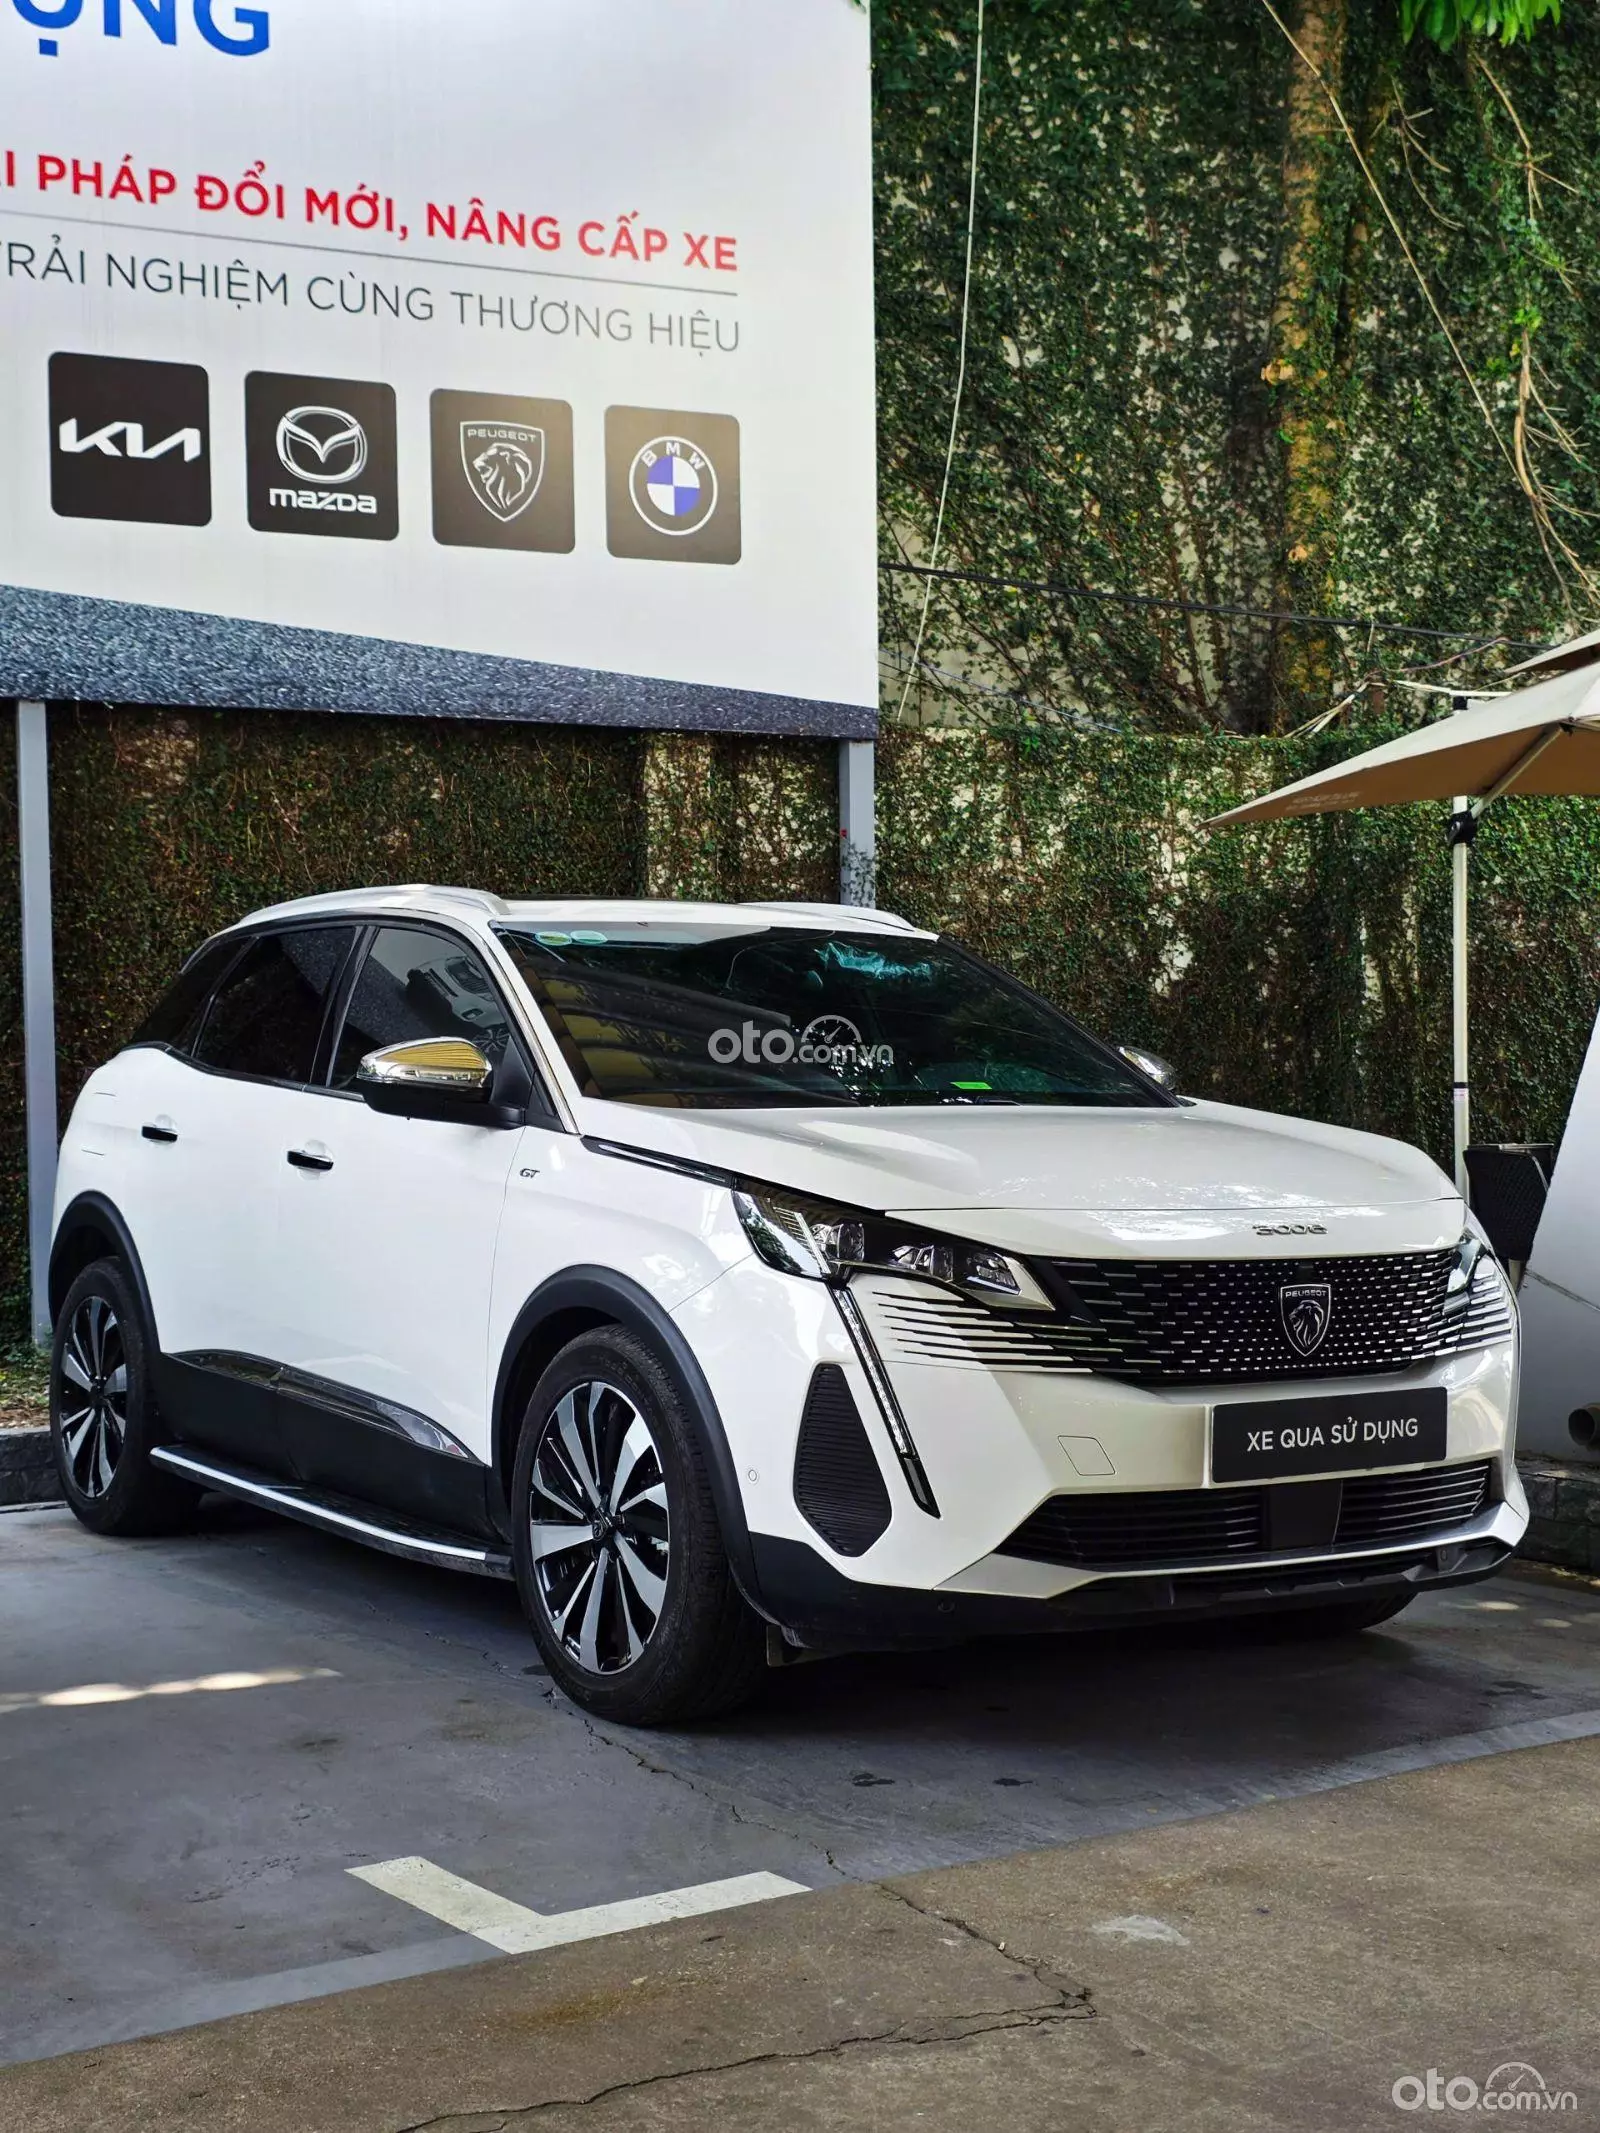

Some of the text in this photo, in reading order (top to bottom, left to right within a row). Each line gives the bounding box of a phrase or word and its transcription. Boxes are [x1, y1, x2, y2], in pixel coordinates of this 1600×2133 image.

[38, 154, 176, 204] PHÁP
[194, 161, 284, 219] ĐỔI
[305, 183, 408, 241] MỚI,
[427, 198, 561, 251] NÂNG
[578, 211, 668, 263] CẤP
[684, 233, 738, 271] XE
[1, 234, 740, 357] RẢI NGHIỆM CÙNG THƯƠNG HIỆU
[467, 428, 537, 443] PEUGEOT
[641, 441, 706, 469] BMW
[519, 1168, 540, 1179] GT
[1285, 1289, 1327, 1298] PEUGEOT
[1247, 1417, 1419, 1452] XE QUA SỬ DỤNG
